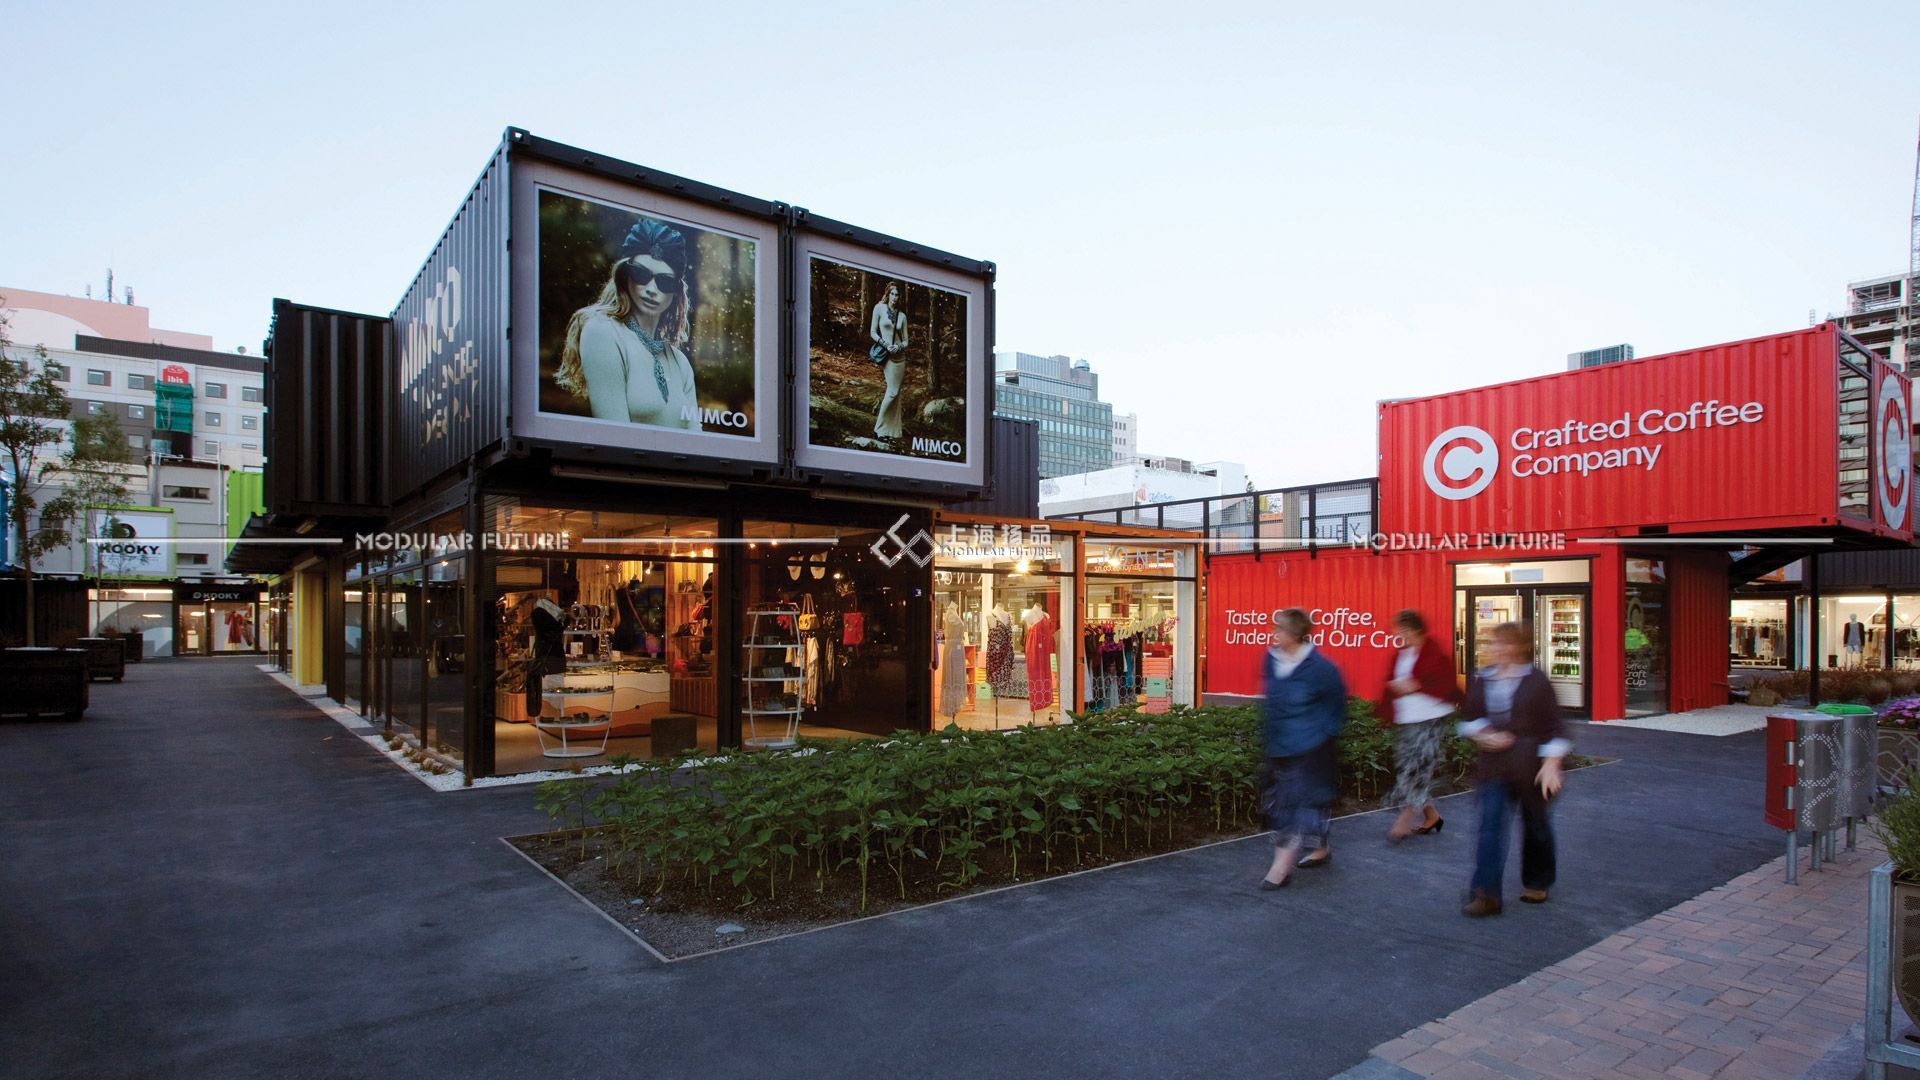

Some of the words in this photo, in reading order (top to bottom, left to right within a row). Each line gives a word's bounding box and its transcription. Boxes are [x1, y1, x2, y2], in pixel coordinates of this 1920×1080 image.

[167, 375, 184, 384] ibis
[680, 404, 748, 429] MIMCO
[1510, 412, 1631, 451] Crafted
[1638, 400, 1764, 436] Coffee
[911, 436, 962, 456] MIMCO
[1510, 444, 1662, 478] Company
[100, 543, 160, 555] KOOKY
[201, 592, 239, 600] KOOKY
[1225, 609, 1267, 625] Taste
[1310, 607, 1377, 630] Coffee,
[1225, 628, 1325, 647] Undersnd
[1328, 630, 1366, 648] Our
[1625, 678, 1648, 688] Cup
